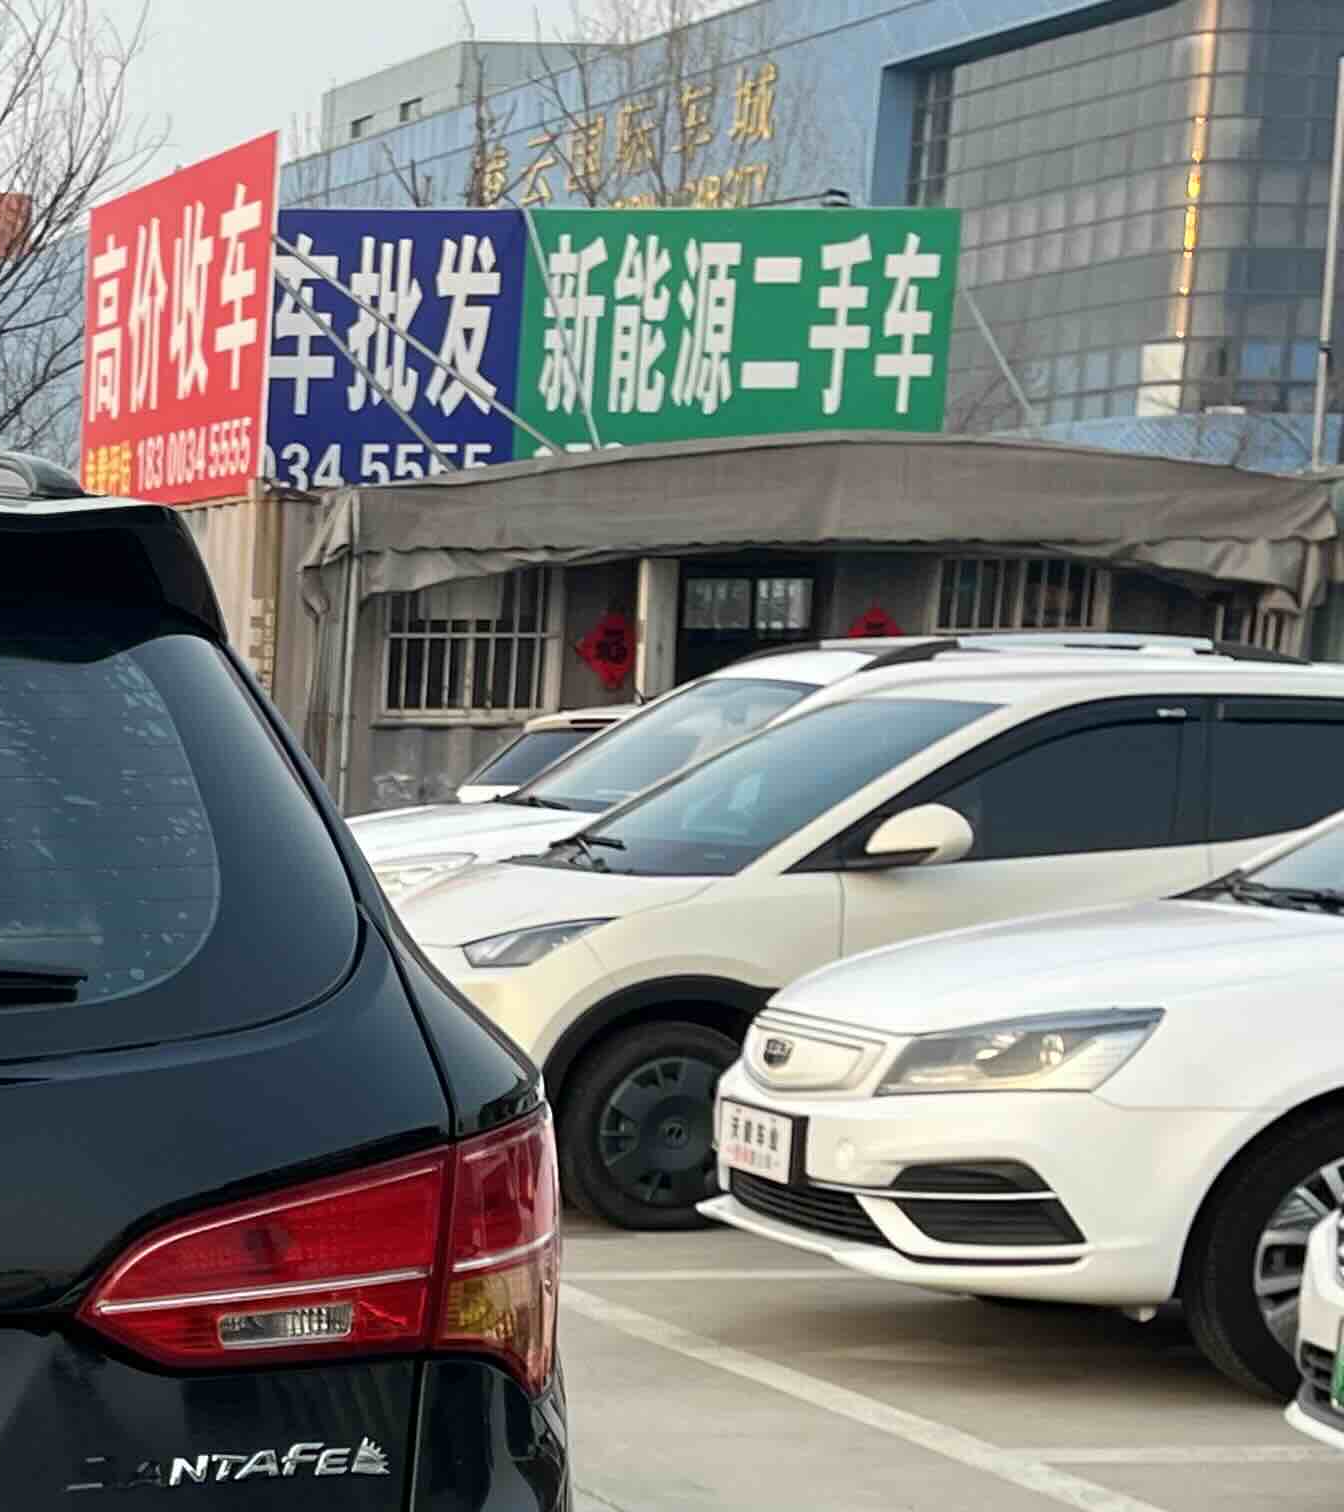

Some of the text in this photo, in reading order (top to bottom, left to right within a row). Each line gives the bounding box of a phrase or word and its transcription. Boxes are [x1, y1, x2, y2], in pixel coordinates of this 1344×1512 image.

[89, 183, 263, 423] 高价收车
[269, 233, 501, 417] 车批发
[538, 233, 941, 415] 新能源二手车
[137, 434, 165, 492] 183
[207, 415, 253, 479] 5555
